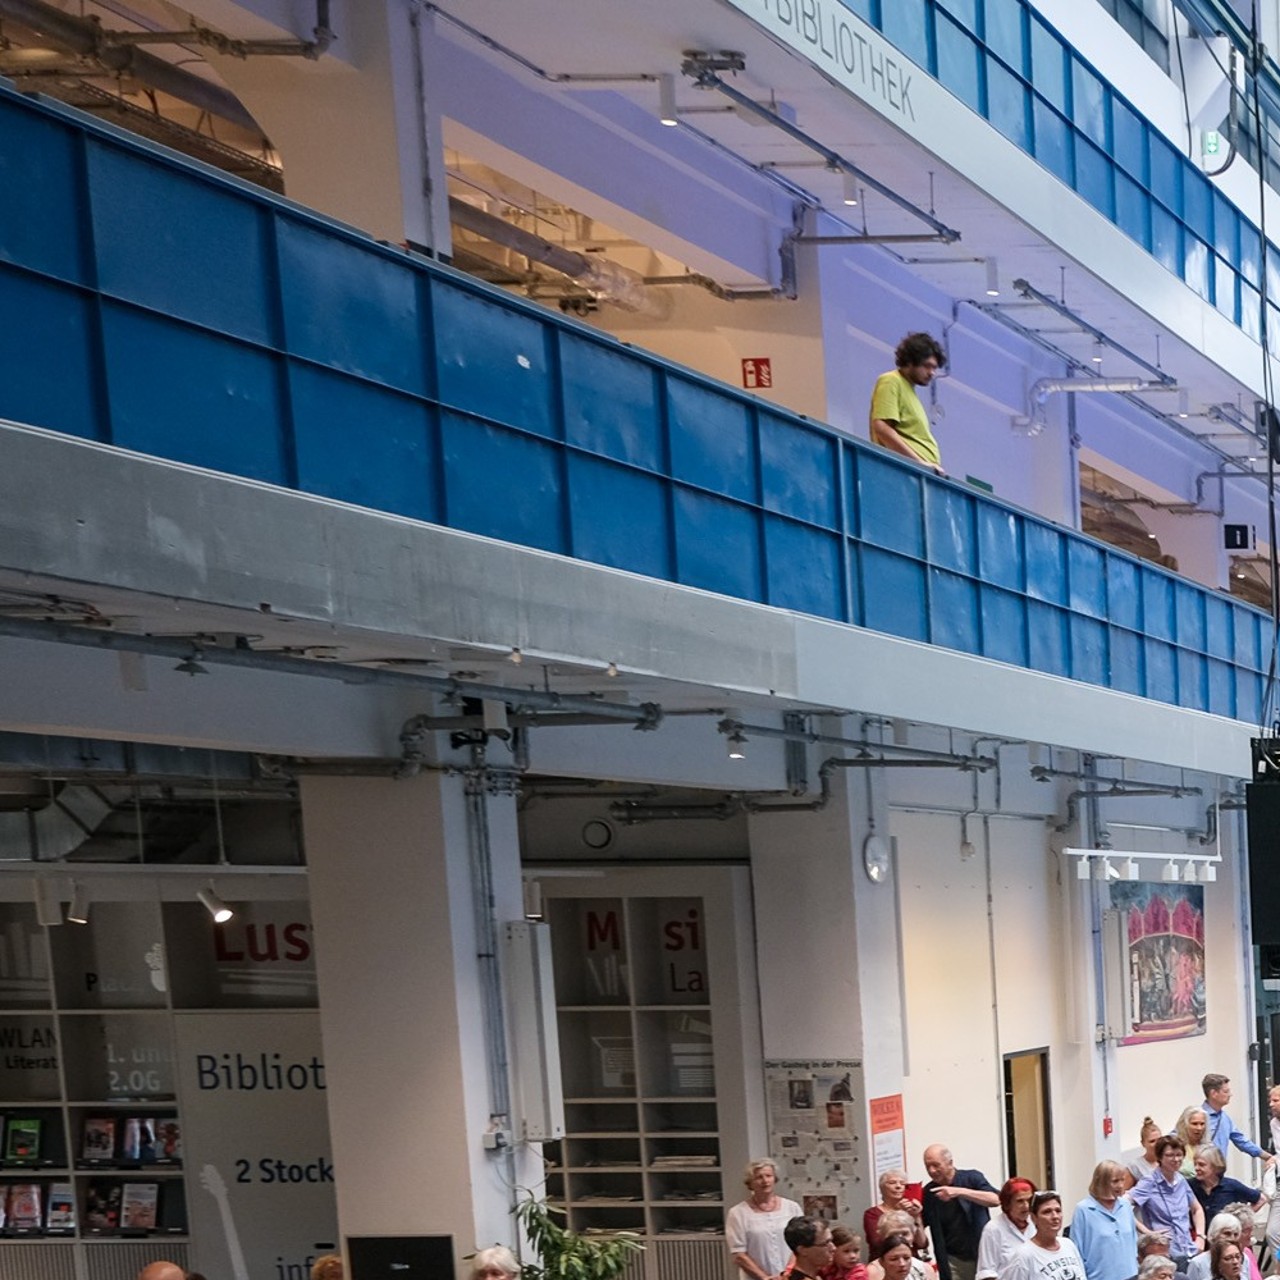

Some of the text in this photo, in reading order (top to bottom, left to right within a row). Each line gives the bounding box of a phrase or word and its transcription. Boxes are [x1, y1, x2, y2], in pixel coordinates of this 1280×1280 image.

[212, 921, 315, 963] Lus
[235, 1157, 335, 1184] 2 Stock
